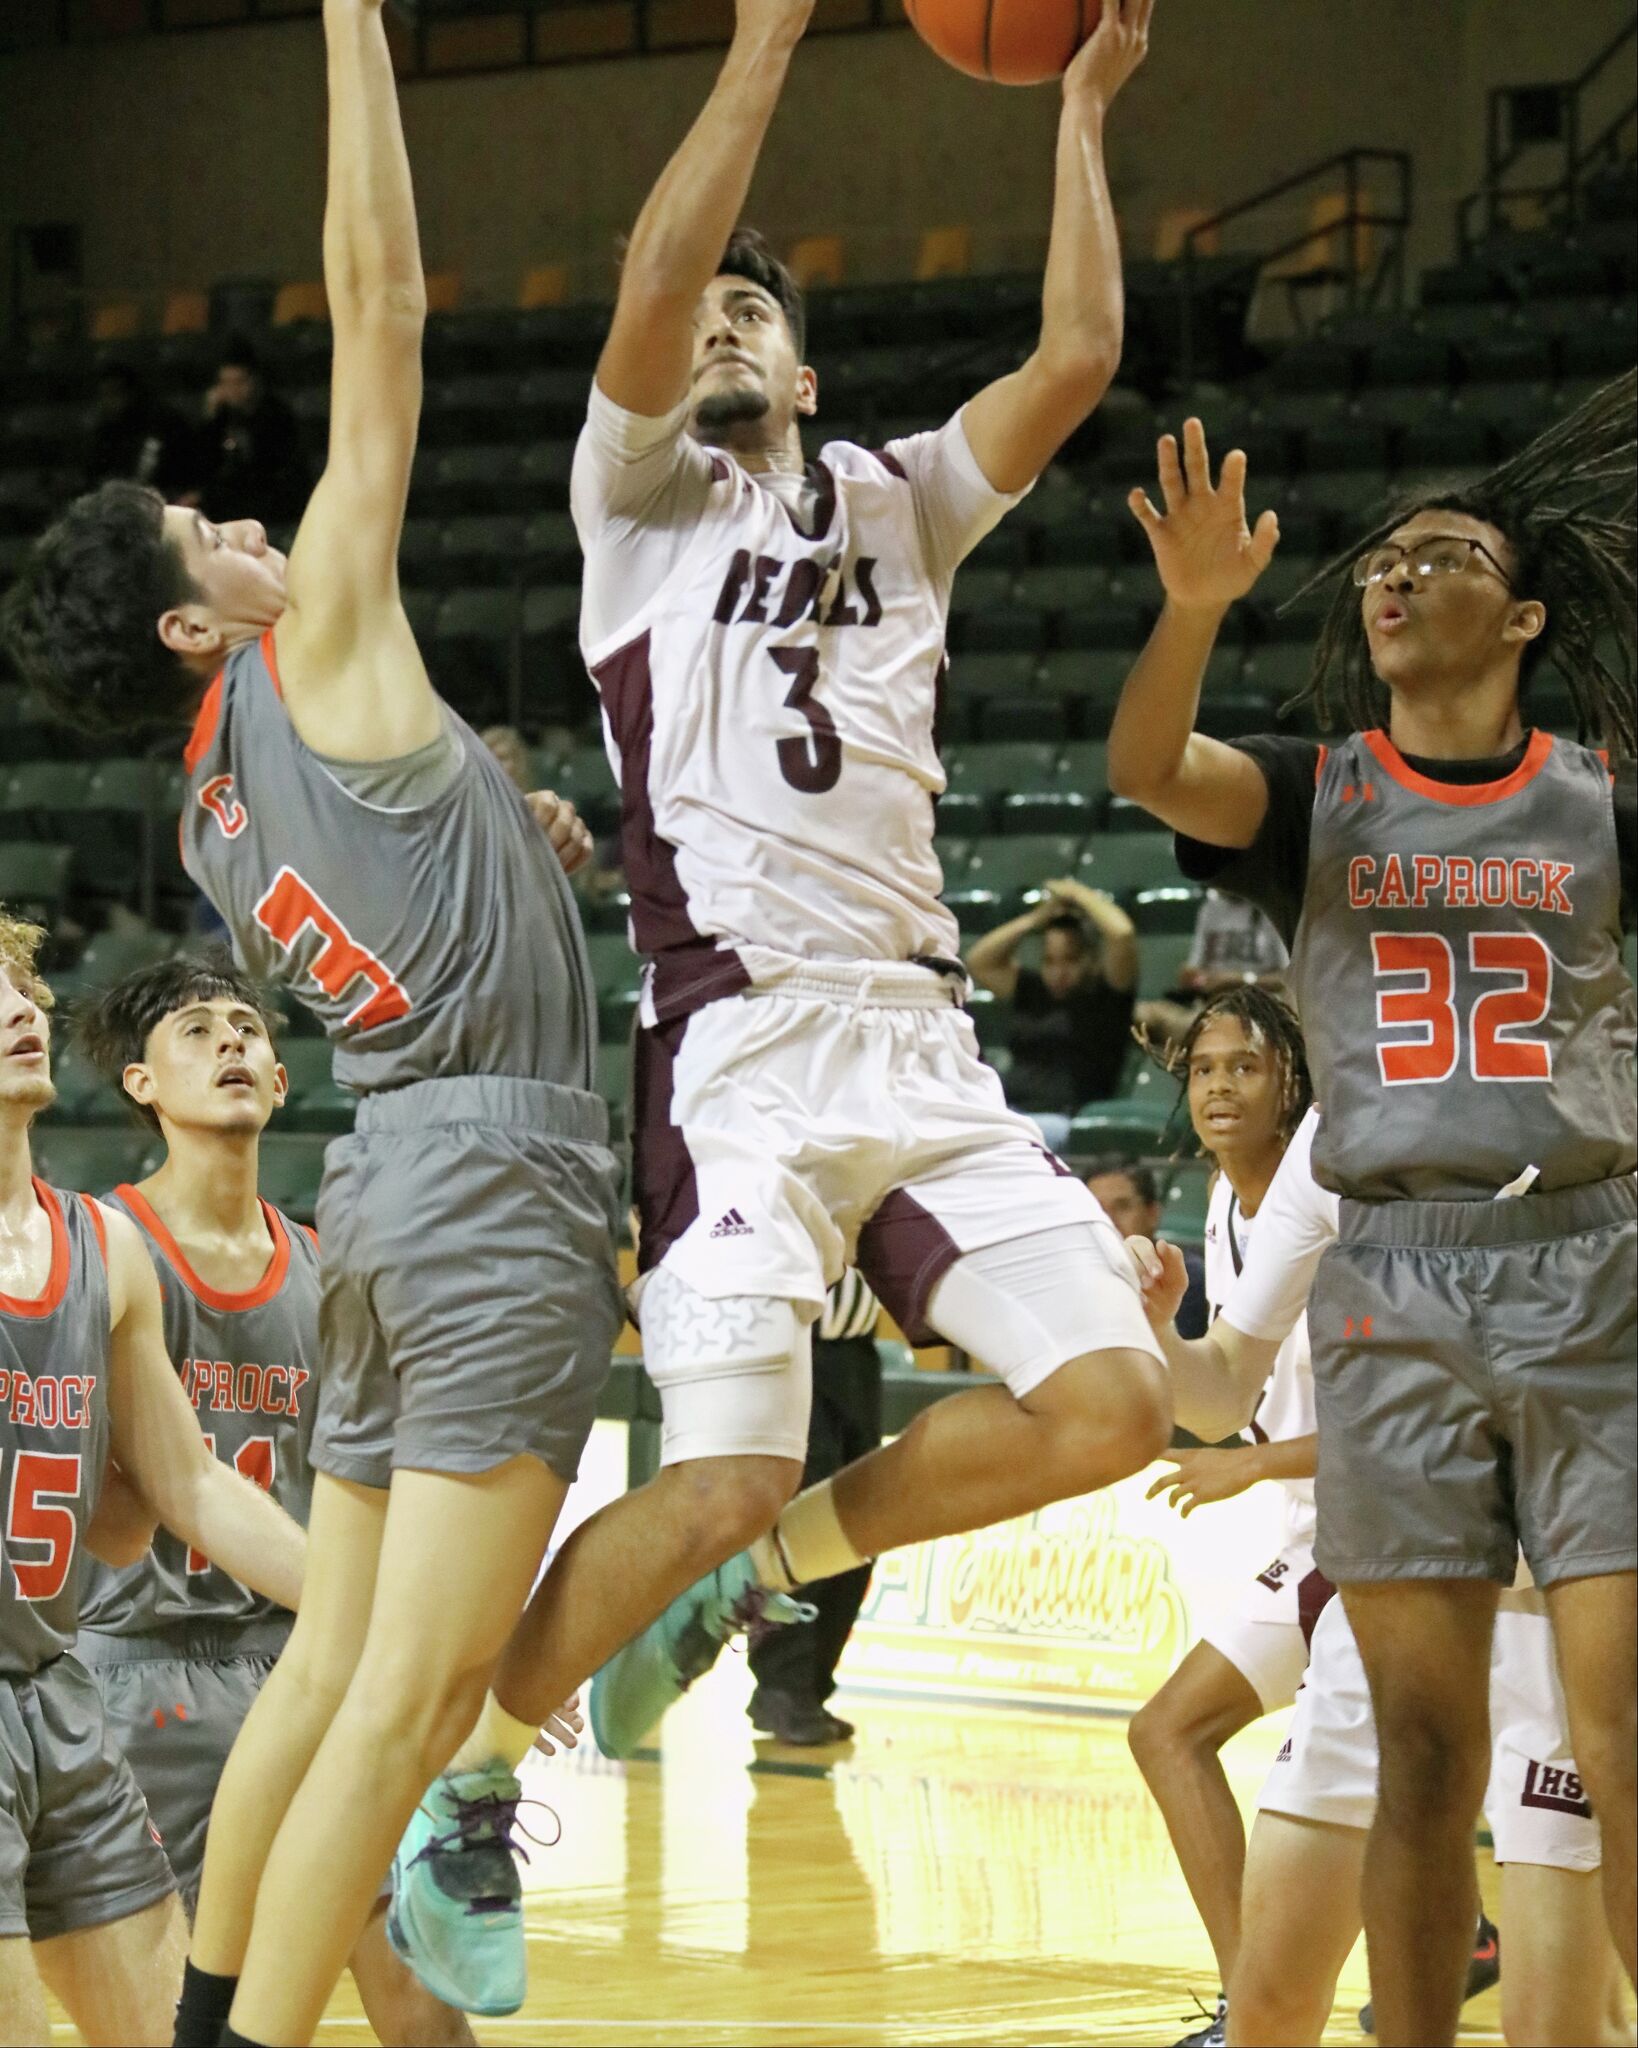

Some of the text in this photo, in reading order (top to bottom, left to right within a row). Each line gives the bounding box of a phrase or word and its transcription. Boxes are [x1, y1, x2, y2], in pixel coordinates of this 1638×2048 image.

[767, 646, 842, 794] 3
[1348, 854, 1574, 915] CAPROCK
[252, 864, 413, 1032] 3
[1370, 932, 1553, 1087] 32
[180, 1358, 310, 1418] PROCK
[1521, 1759, 1592, 1819] LHS
